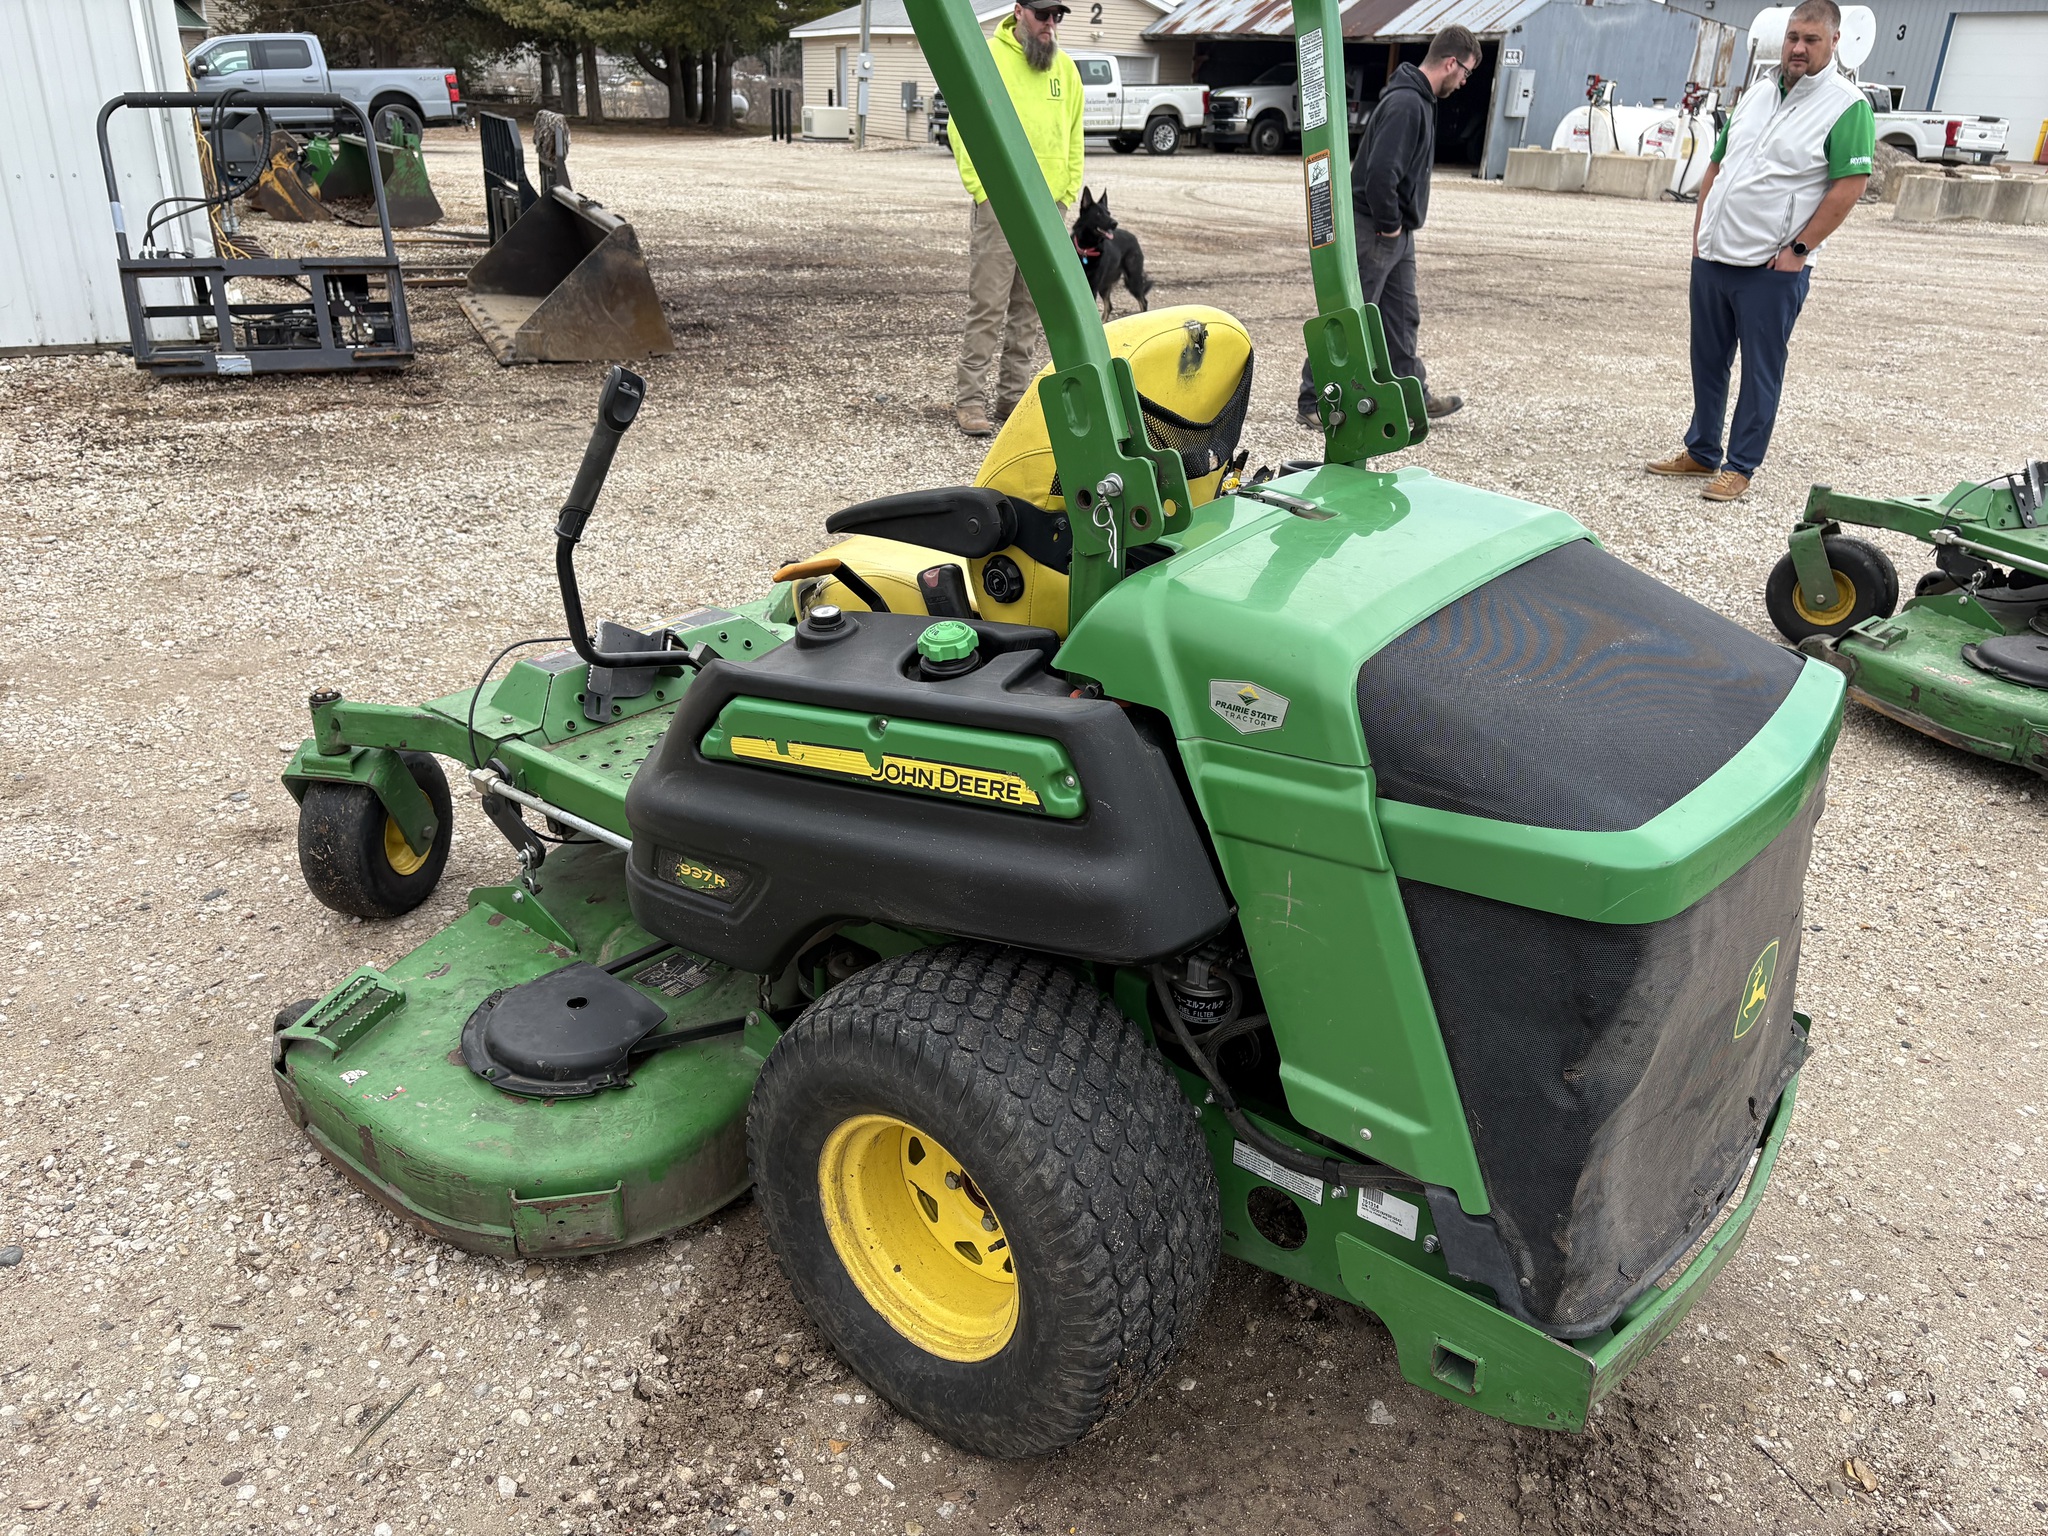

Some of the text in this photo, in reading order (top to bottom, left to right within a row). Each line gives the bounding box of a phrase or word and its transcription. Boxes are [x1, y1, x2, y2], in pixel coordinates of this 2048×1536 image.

[1090, 2, 1103, 24] 2
[1896, 24, 1907, 41] 3
[1215, 700, 1279, 723] PRAIRIE STATE
[1224, 710, 1267, 727] TRACTOR
[871, 757, 1022, 802] JOHN DEERE
[1178, 1004, 1191, 1015] FUEL
[1192, 1010, 1214, 1018] FILTER
